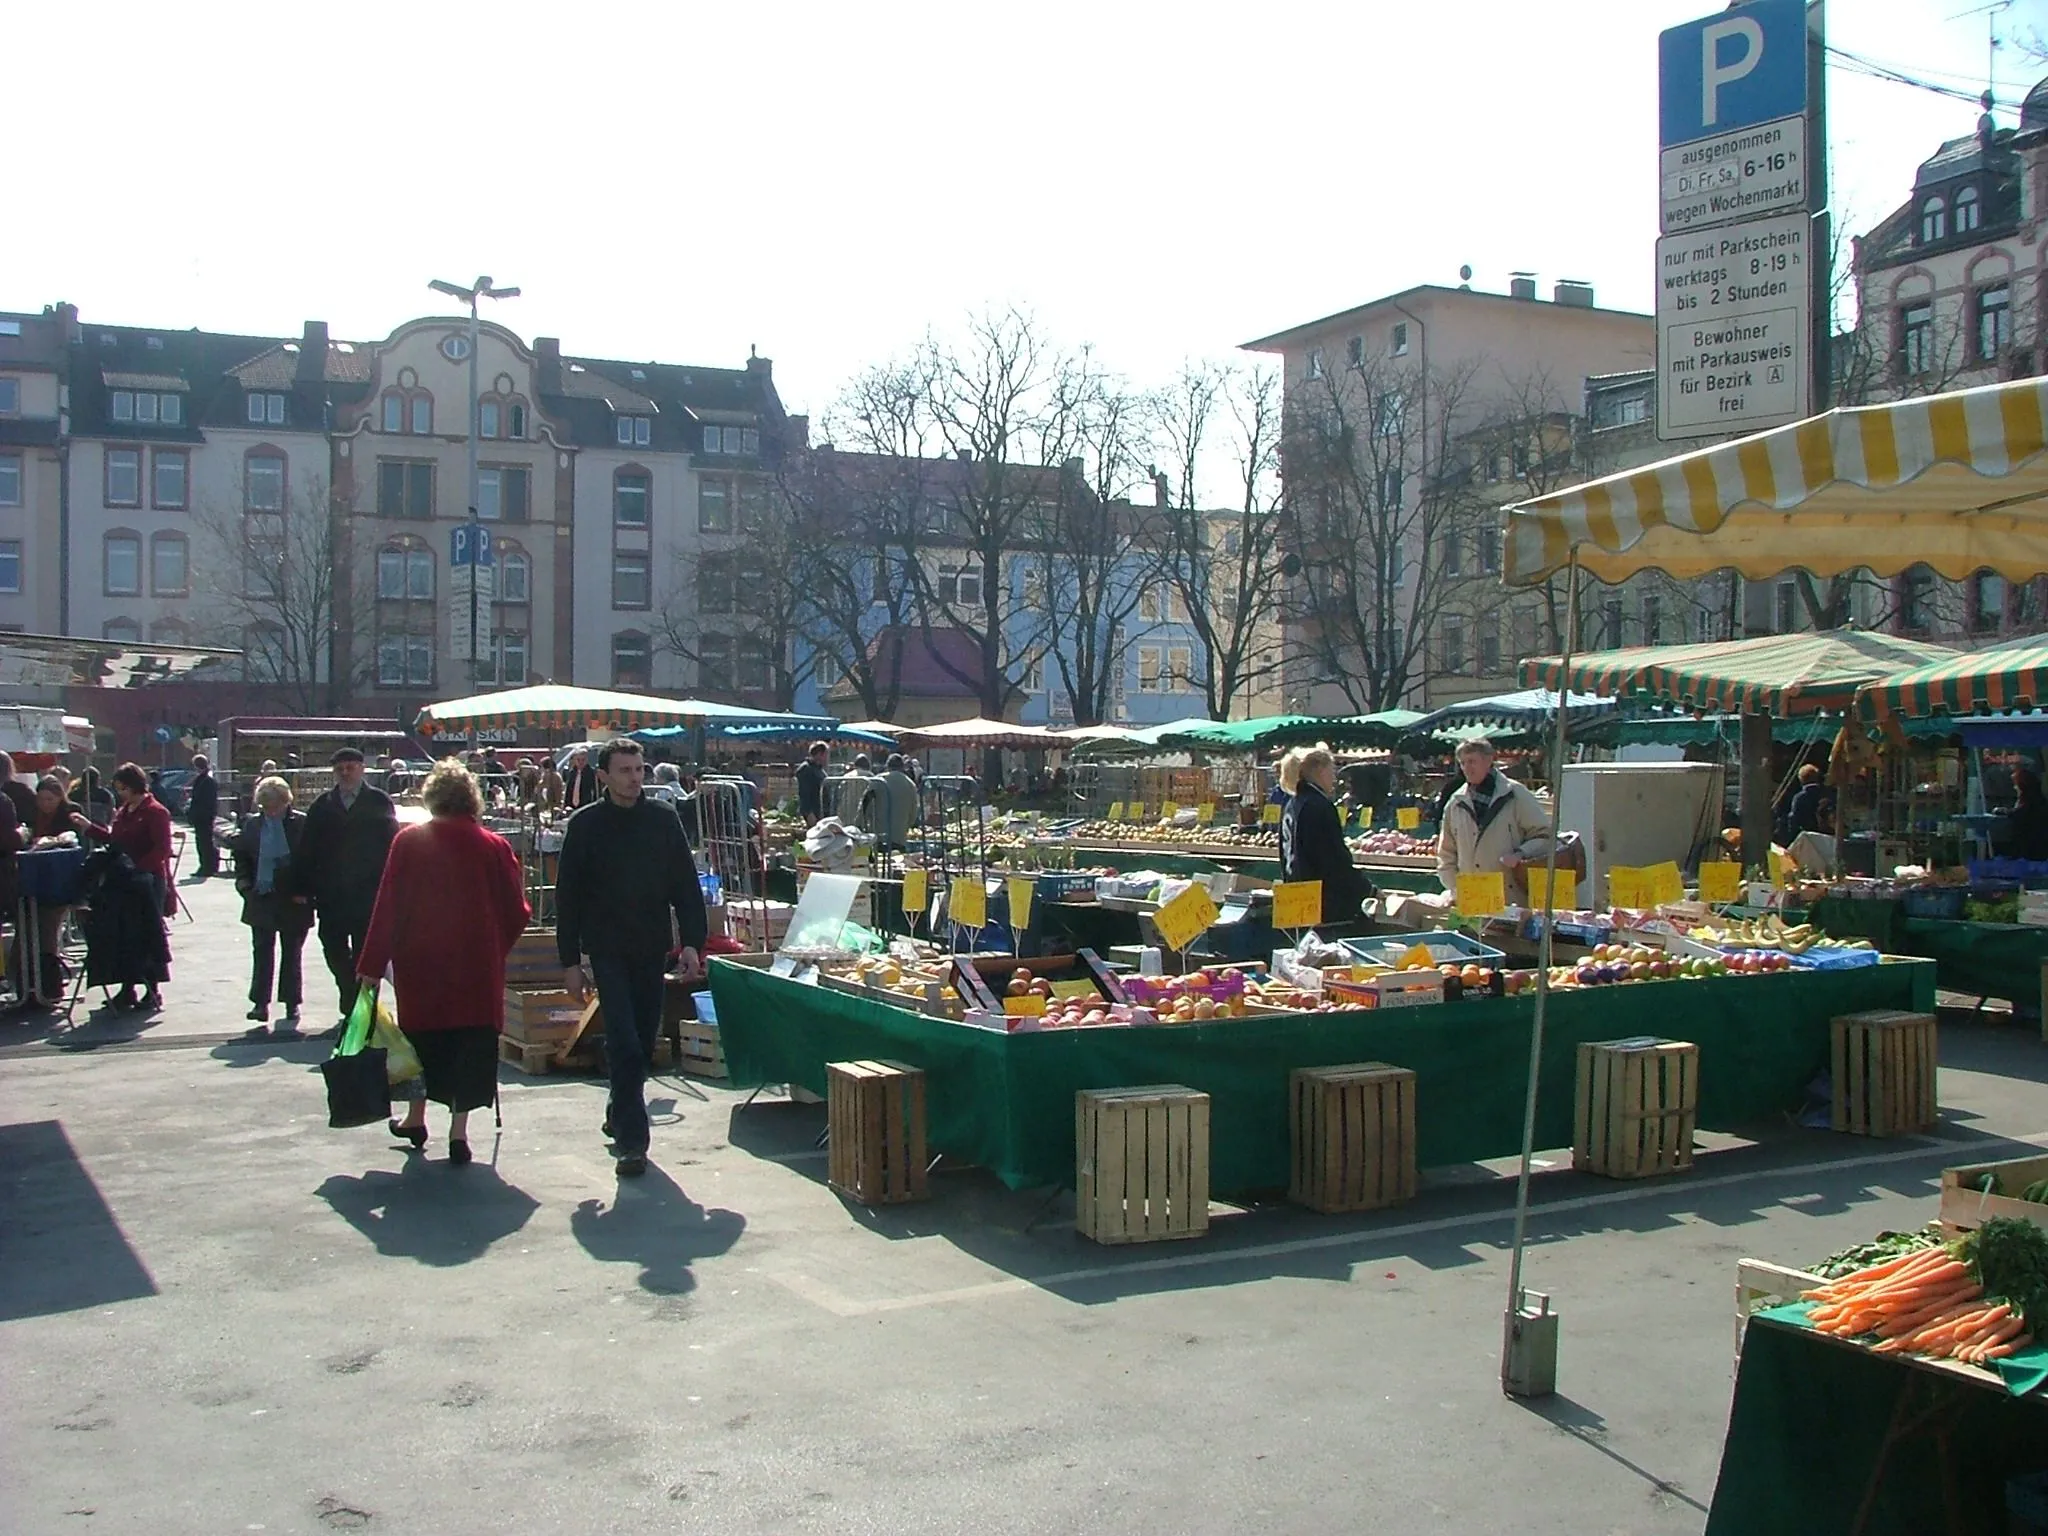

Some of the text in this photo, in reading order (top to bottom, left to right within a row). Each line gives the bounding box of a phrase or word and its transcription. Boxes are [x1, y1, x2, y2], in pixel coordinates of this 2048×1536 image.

[1702, 16, 1764, 127] P
[1682, 129, 1781, 164] ausgenommen
[1788, 151, 1797, 163] h
[1665, 180, 1800, 224] wegen Wochenmarkt
[1665, 229, 1800, 267] nur mit Parkschein
[1664, 267, 1727, 289] werktags
[1793, 254, 1800, 264] h
[1677, 280, 1787, 311] bis 2 Stunden
[1694, 324, 1769, 347] Bewohner
[1673, 342, 1792, 373] mit Parkausweis
[1680, 378, 1700, 394] für
[1706, 370, 1752, 391] Bezirk
[1719, 394, 1744, 412] frei
[456, 530, 466, 562] P
[480, 529, 488, 561] P
[453, 730, 497, 739] KISK
